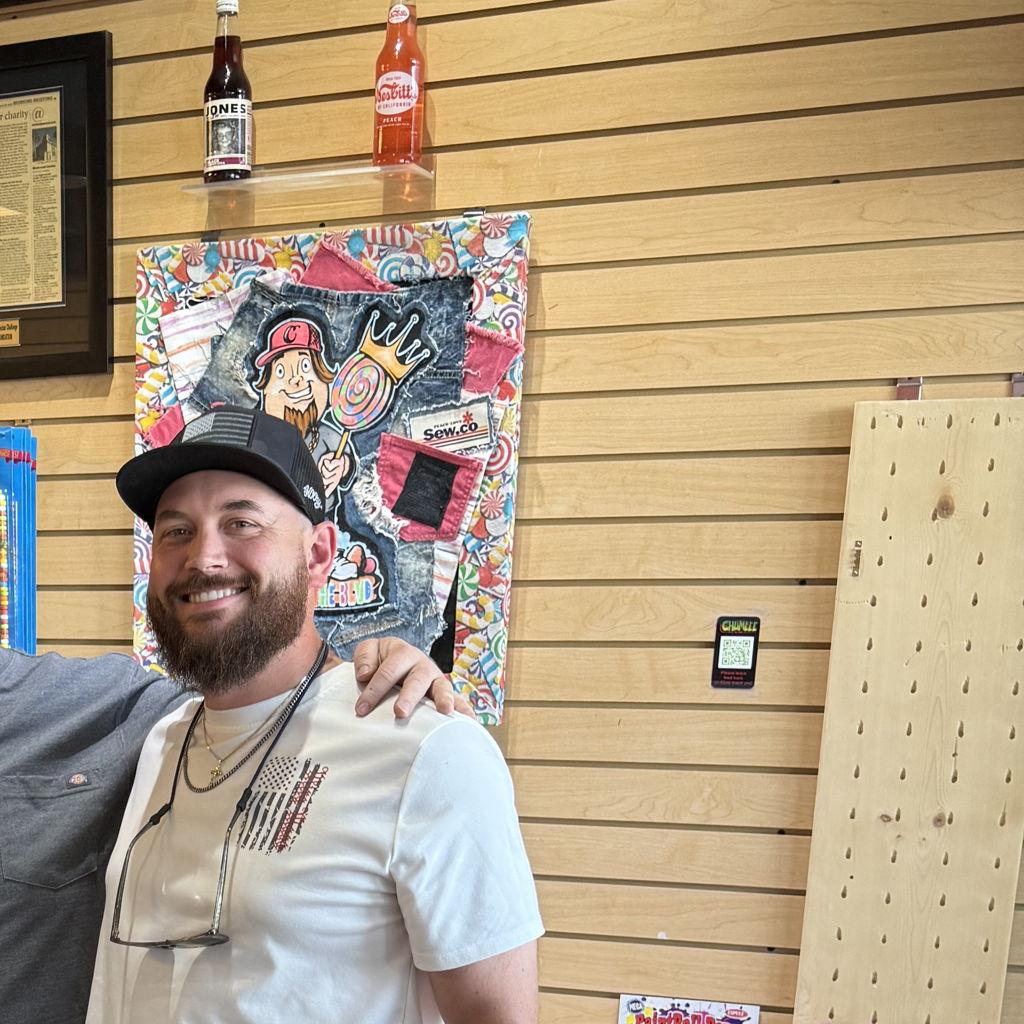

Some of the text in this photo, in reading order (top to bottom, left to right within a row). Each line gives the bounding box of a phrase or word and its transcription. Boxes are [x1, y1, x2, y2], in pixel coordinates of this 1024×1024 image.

[4, 109, 29, 121] charity
[206, 103, 246, 117] JONES
[423, 422, 479, 441] Sew.co
